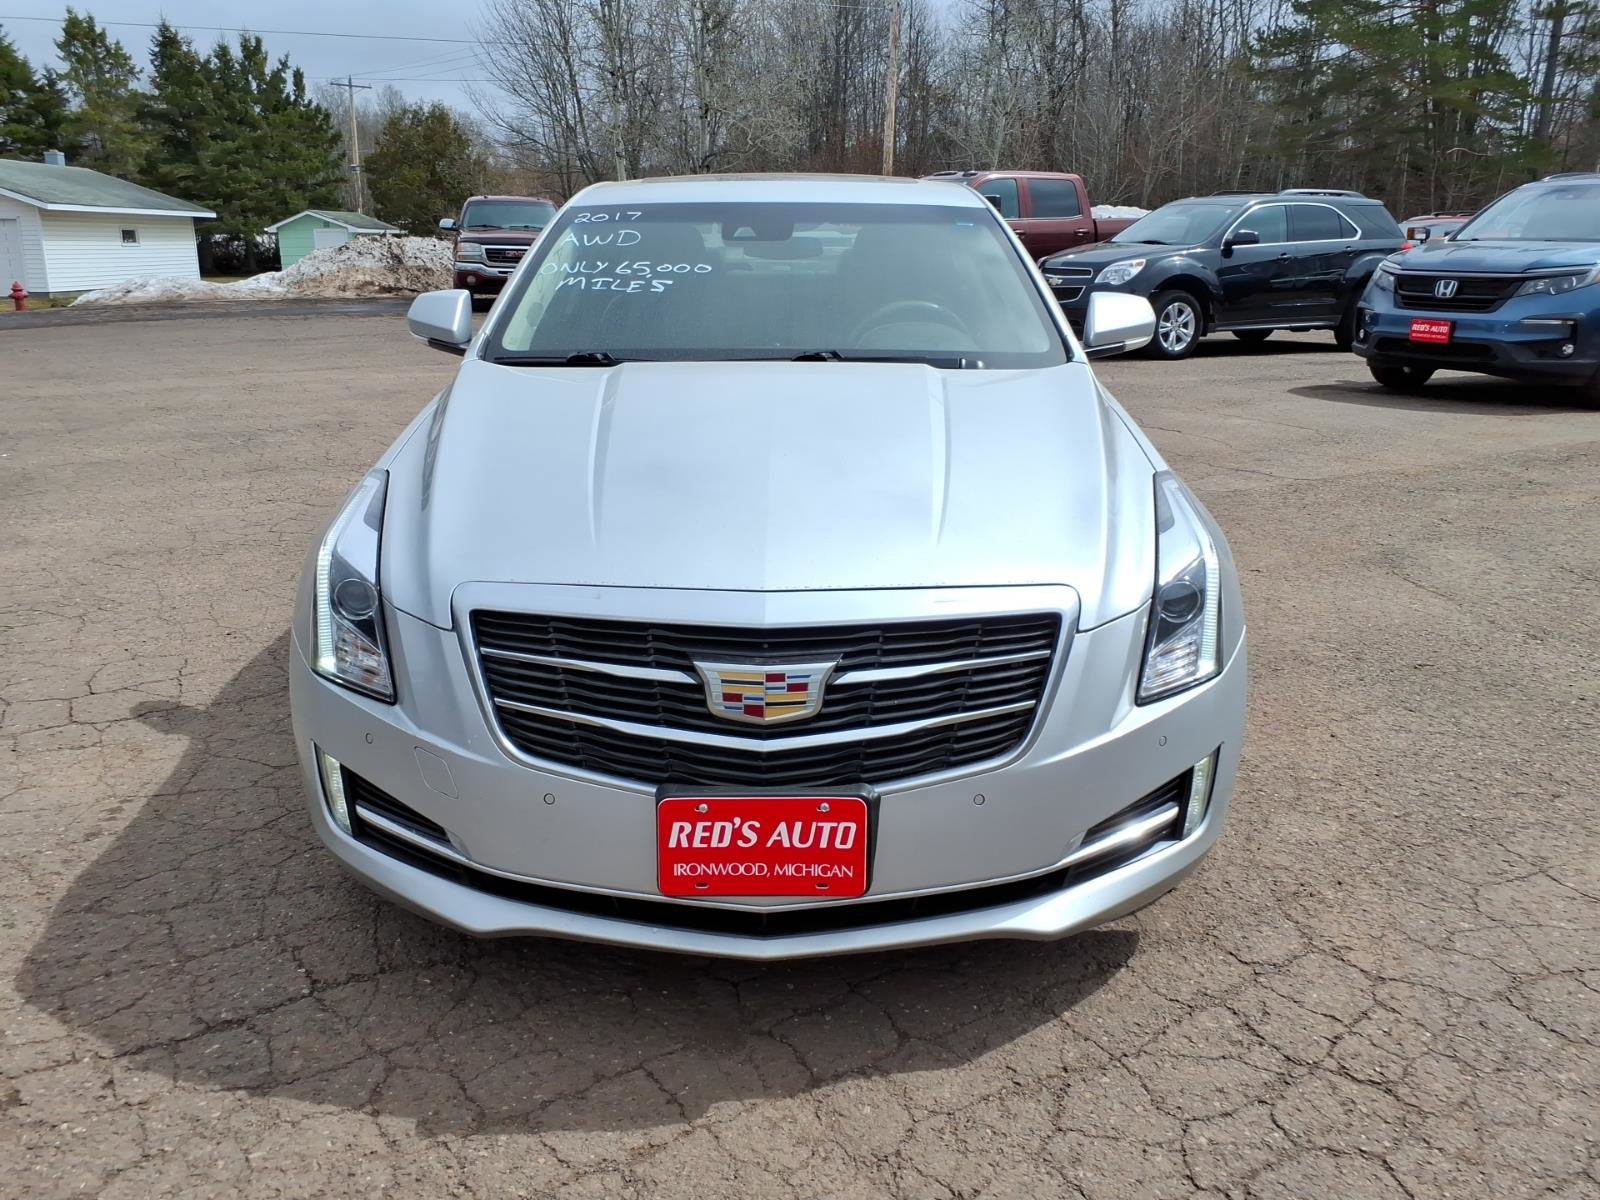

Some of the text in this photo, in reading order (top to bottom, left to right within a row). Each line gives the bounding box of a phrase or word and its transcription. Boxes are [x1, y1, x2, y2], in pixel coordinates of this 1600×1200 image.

[574, 211, 642, 223] 2017
[561, 230, 641, 247] AWD
[540, 260, 712, 278] ONLY 65,000
[555, 276, 673, 293] MILES
[1411, 323, 1448, 333] RED'S AUTO
[668, 816, 857, 849] RED'S AUTO
[673, 862, 853, 878] IRONWOOD, MICHIGAN
